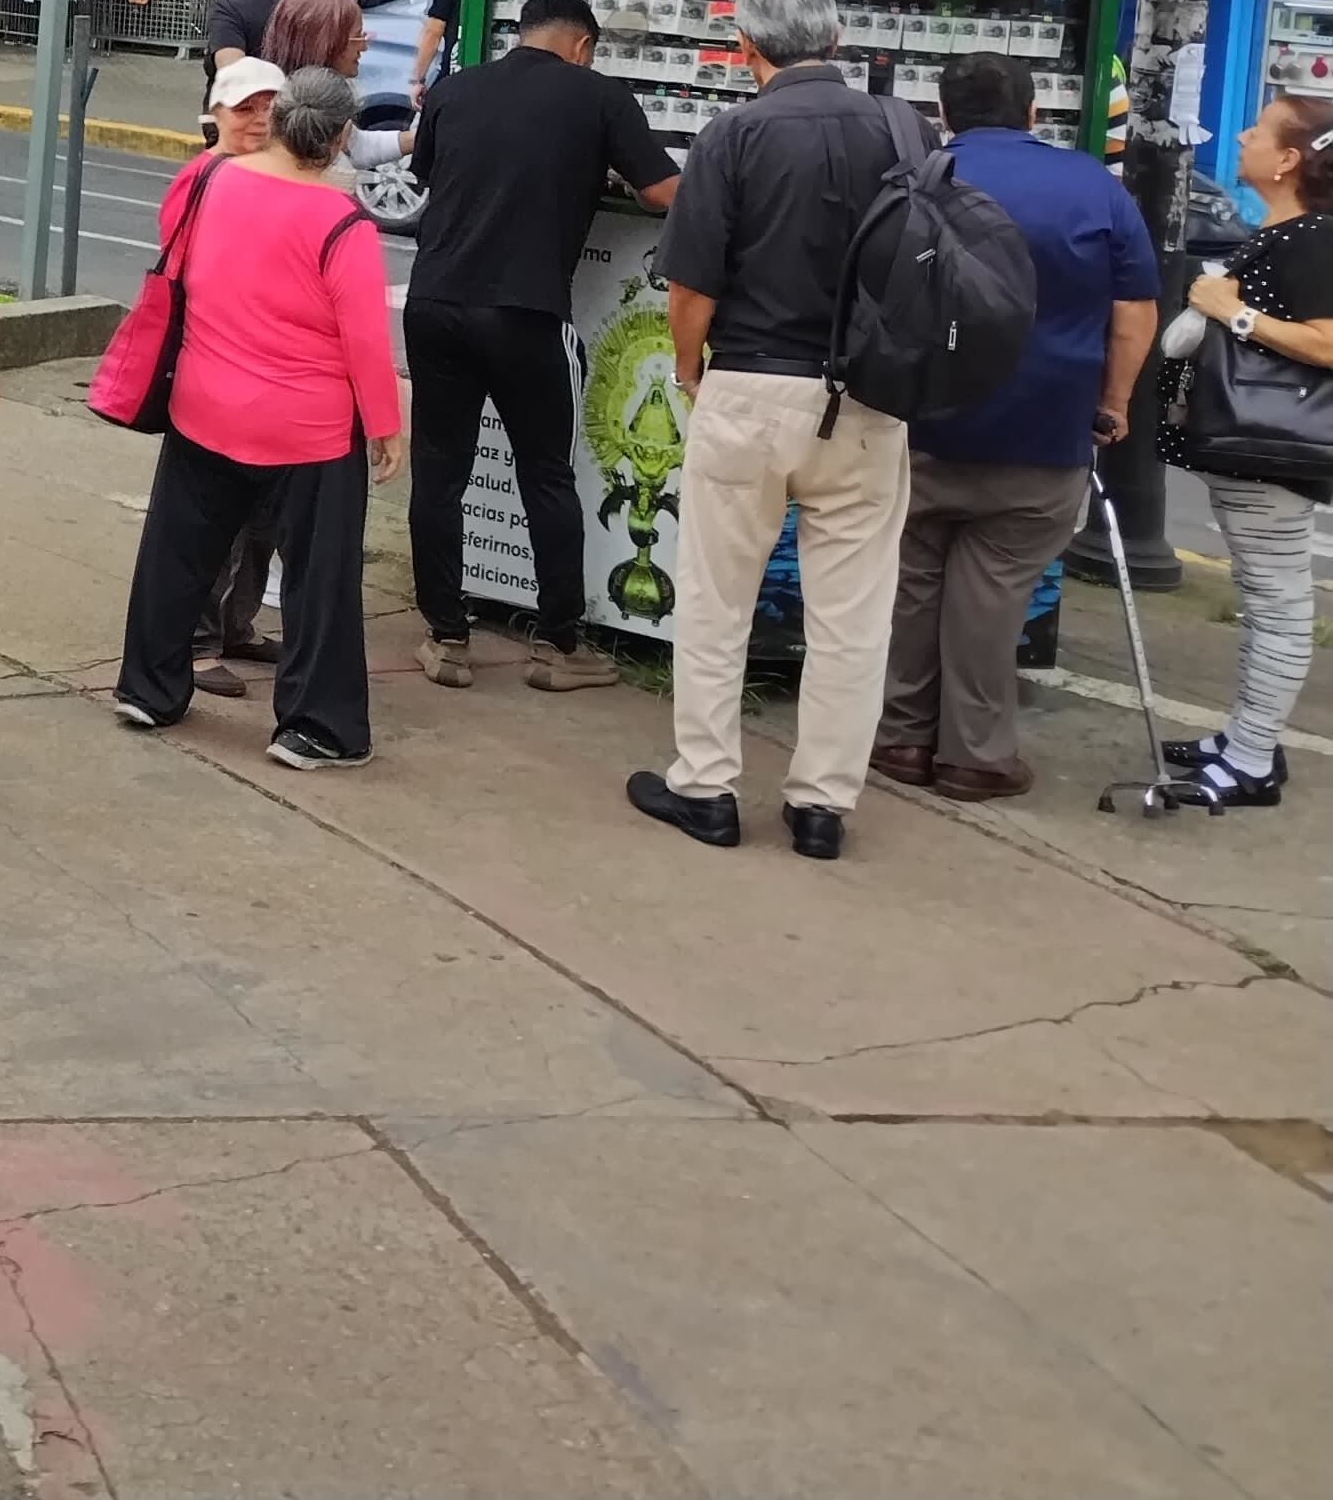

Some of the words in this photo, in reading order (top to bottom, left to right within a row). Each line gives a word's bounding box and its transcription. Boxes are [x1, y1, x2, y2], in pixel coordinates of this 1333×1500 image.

[467, 473, 515, 495] salud.
[462, 502, 505, 523] acias
[461, 531, 533, 561] eferirnos.
[462, 562, 539, 592] ndiciones
